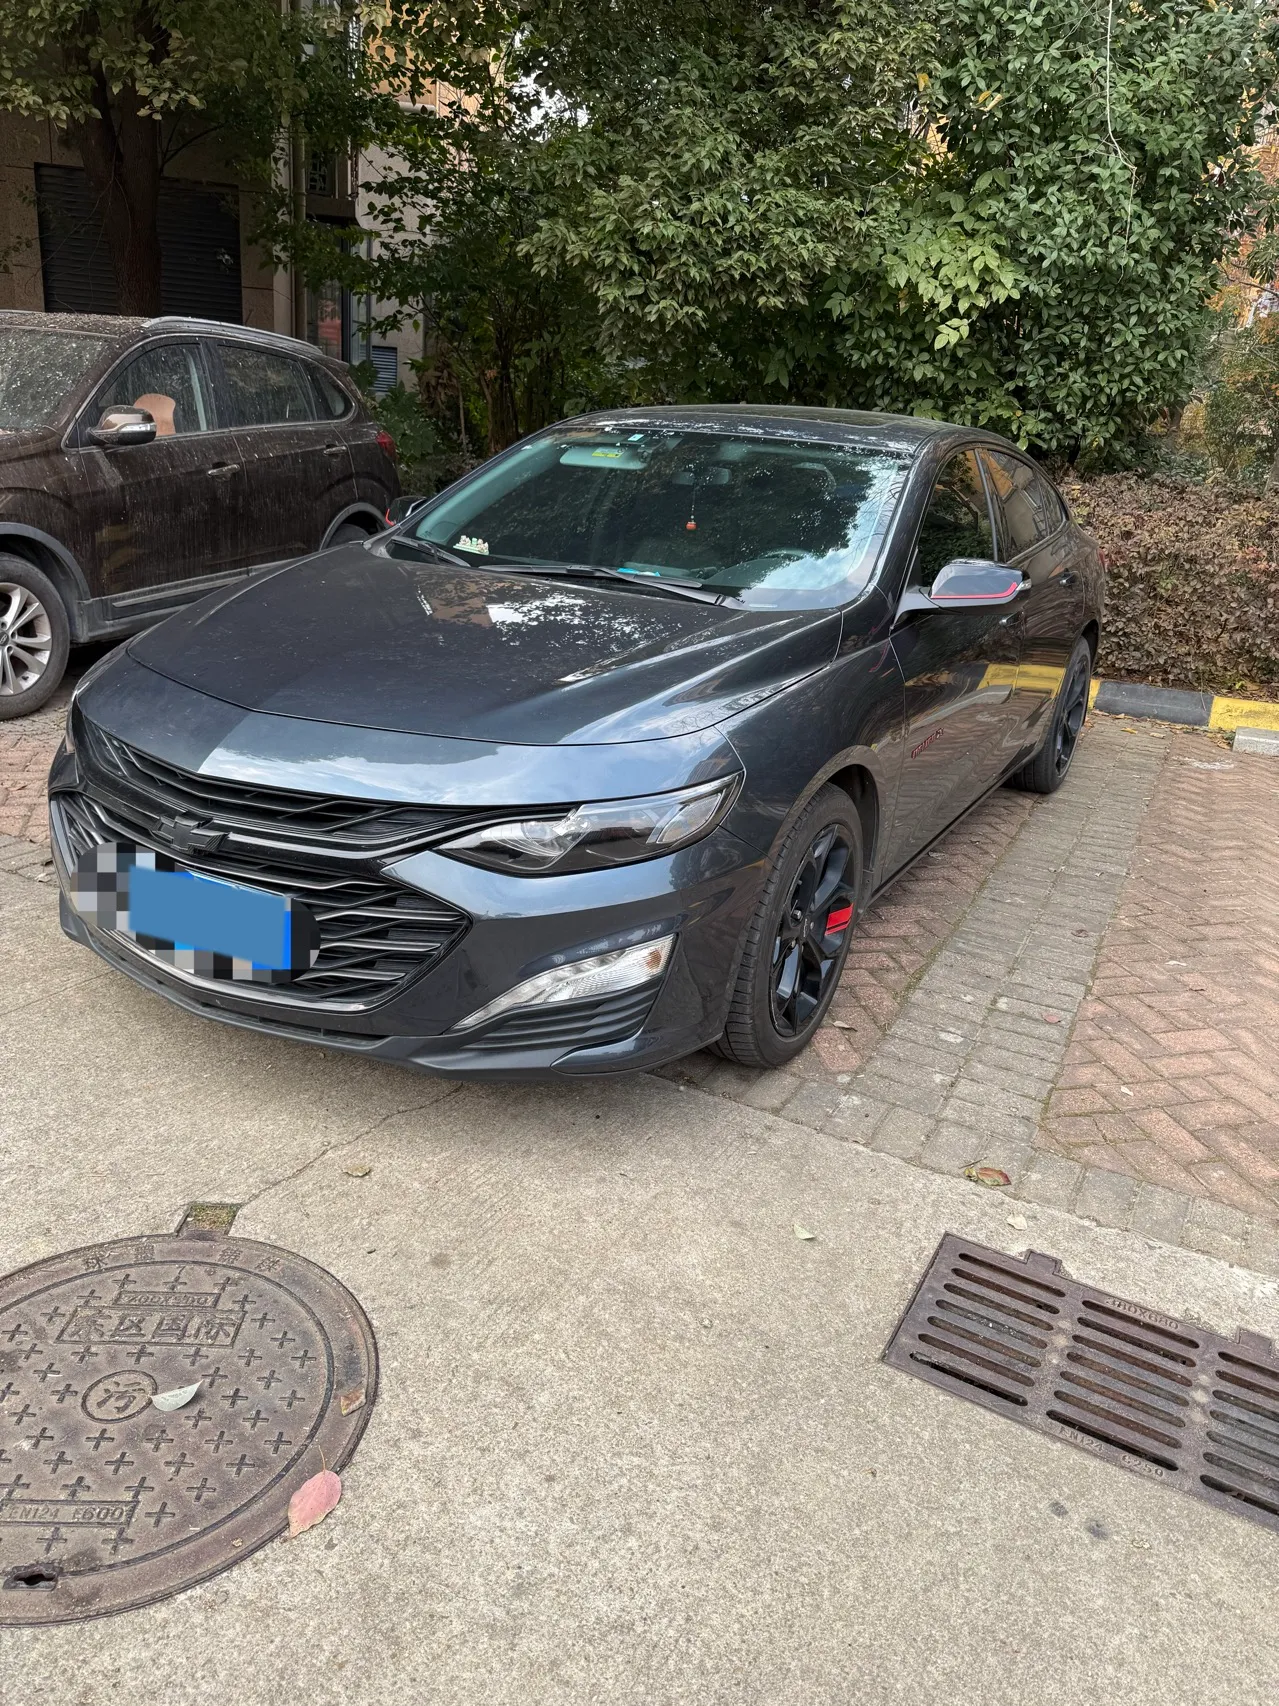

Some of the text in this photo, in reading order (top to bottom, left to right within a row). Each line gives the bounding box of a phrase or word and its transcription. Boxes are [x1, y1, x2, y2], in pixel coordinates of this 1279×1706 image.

[96, 1381, 146, 1414] 污
[1058, 1426, 1165, 1479] EN124 C250
[8, 1505, 60, 1520] EN124
